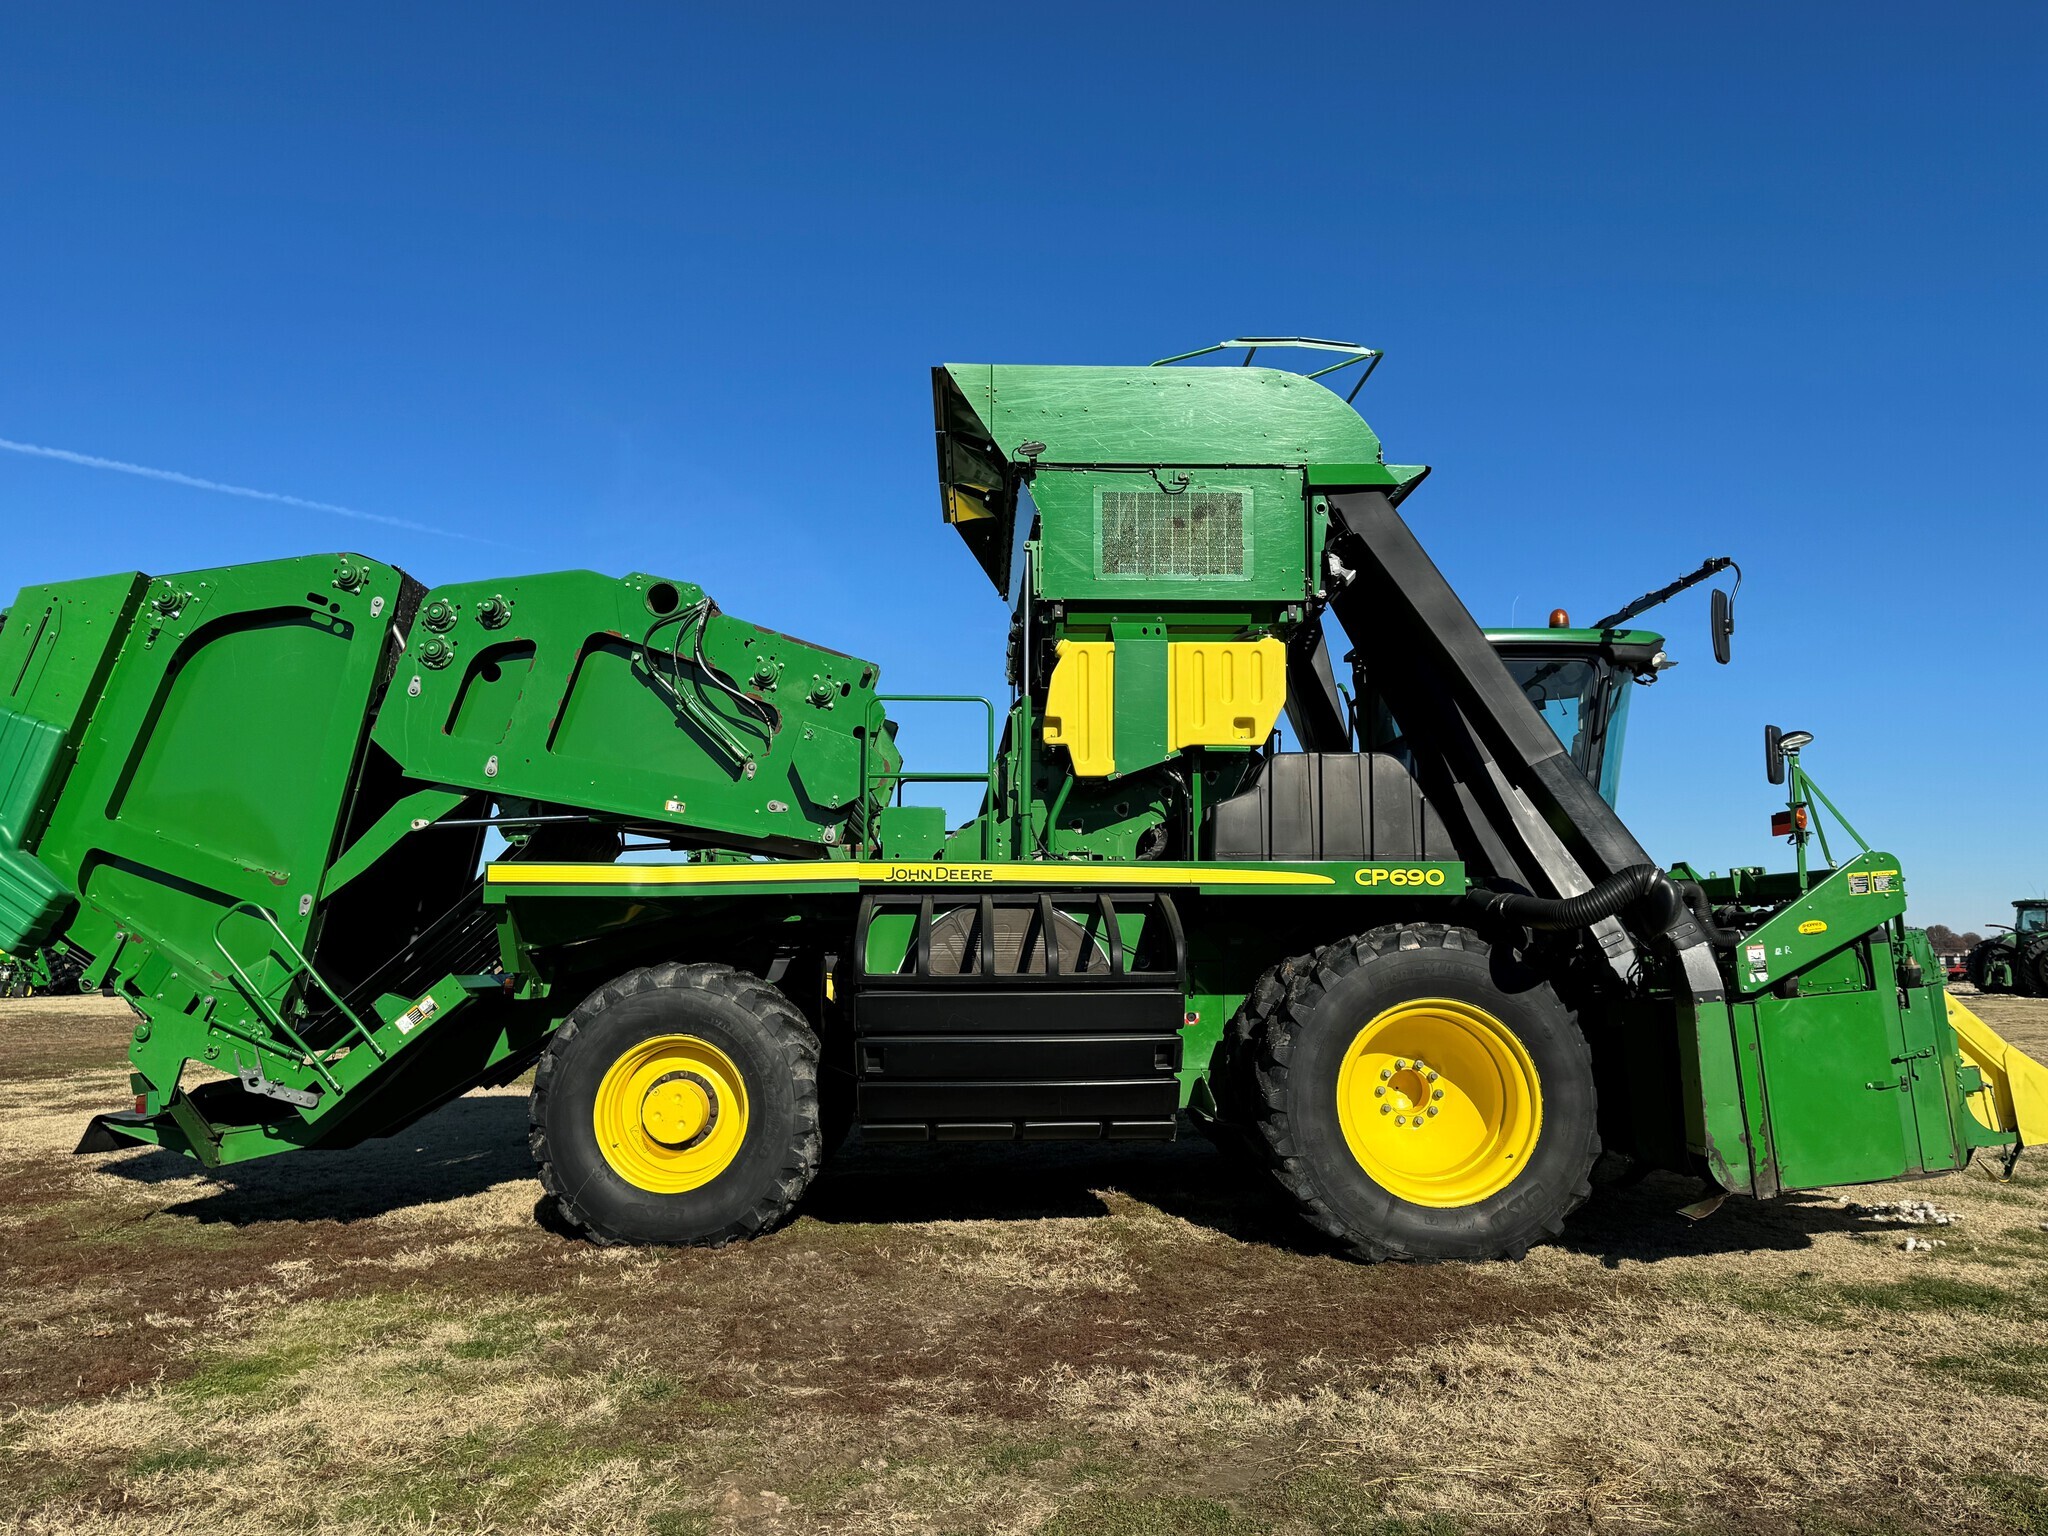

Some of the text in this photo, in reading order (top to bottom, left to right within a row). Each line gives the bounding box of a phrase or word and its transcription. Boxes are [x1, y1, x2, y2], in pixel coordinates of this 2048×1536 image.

[885, 866, 993, 880] JOHN DEERE
[1354, 868, 1446, 886] CP690
